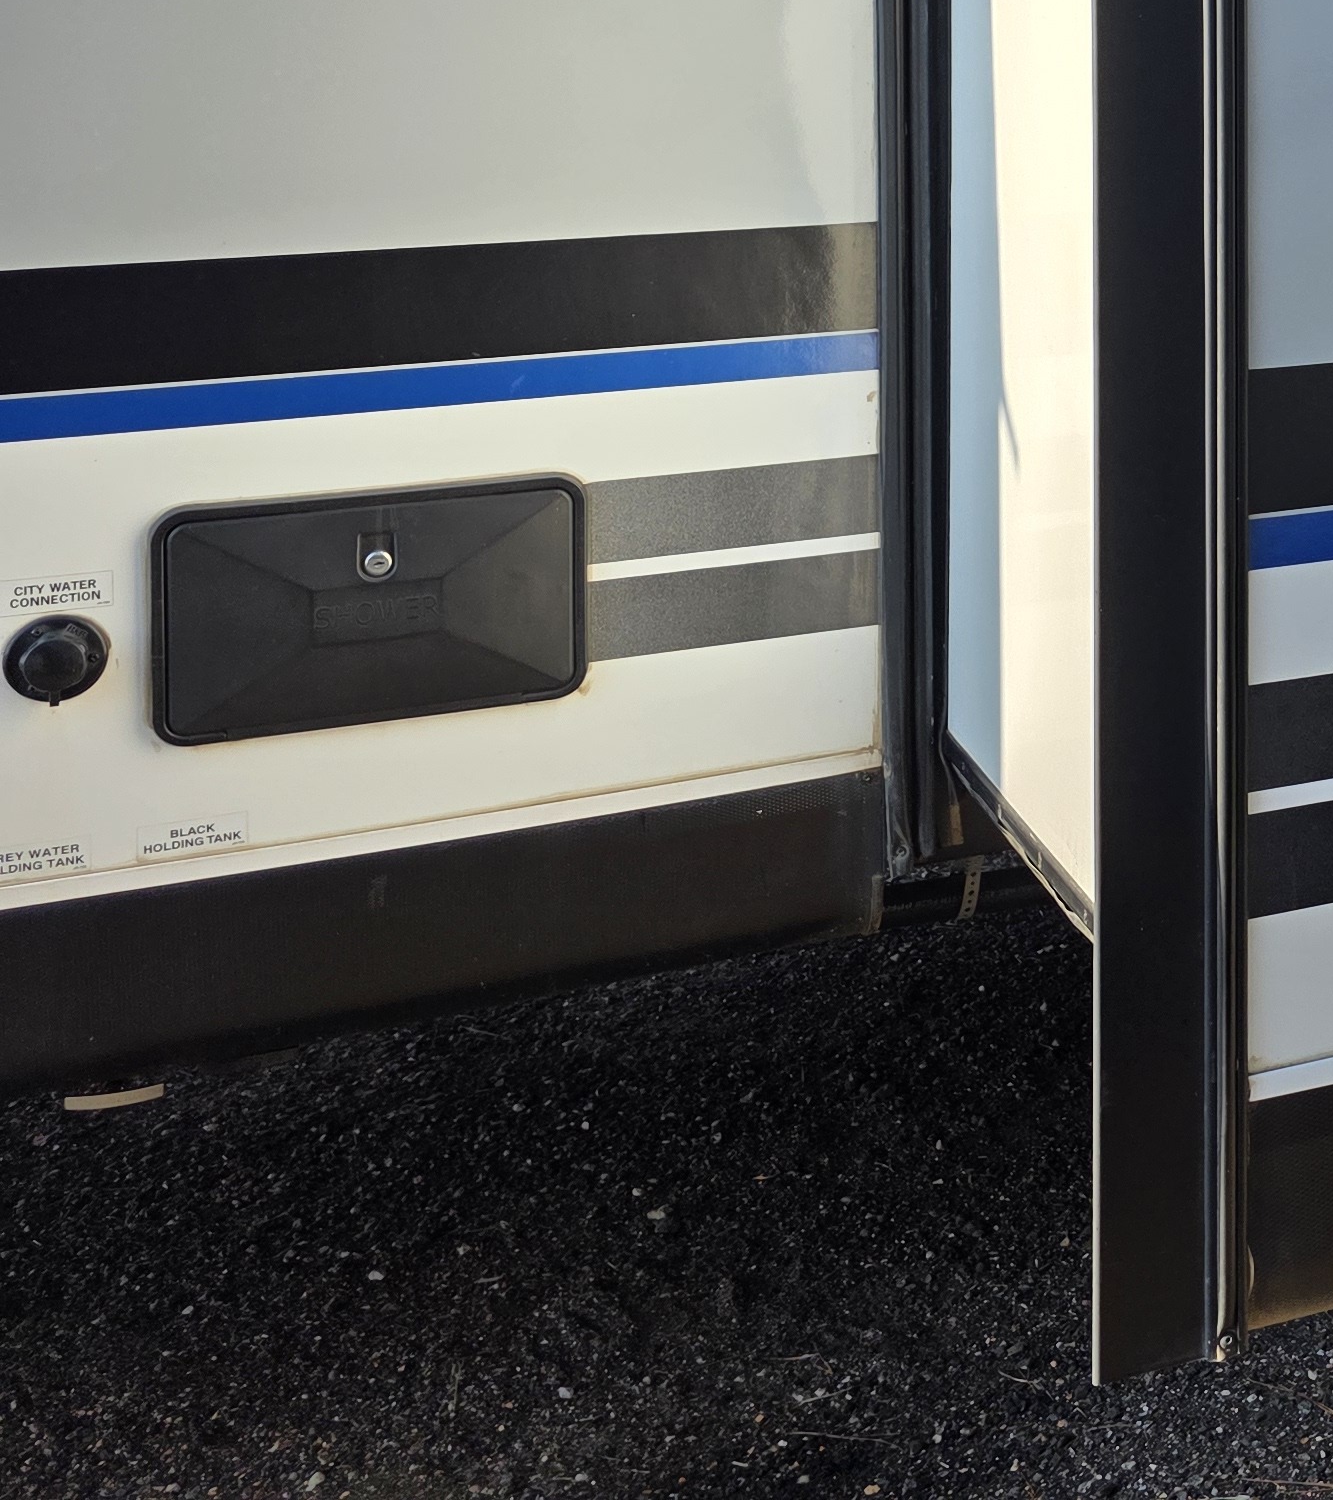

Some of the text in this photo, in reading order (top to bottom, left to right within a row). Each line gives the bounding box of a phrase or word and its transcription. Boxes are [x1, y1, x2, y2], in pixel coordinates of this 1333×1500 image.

[14, 579, 97, 596] CITY WATER
[10, 590, 101, 609] CONNECTION
[170, 823, 215, 839] BLACK
[143, 830, 242, 854] HOLDING TANK
[29, 843, 80, 859] WATER
[46, 854, 85, 868] TANK
